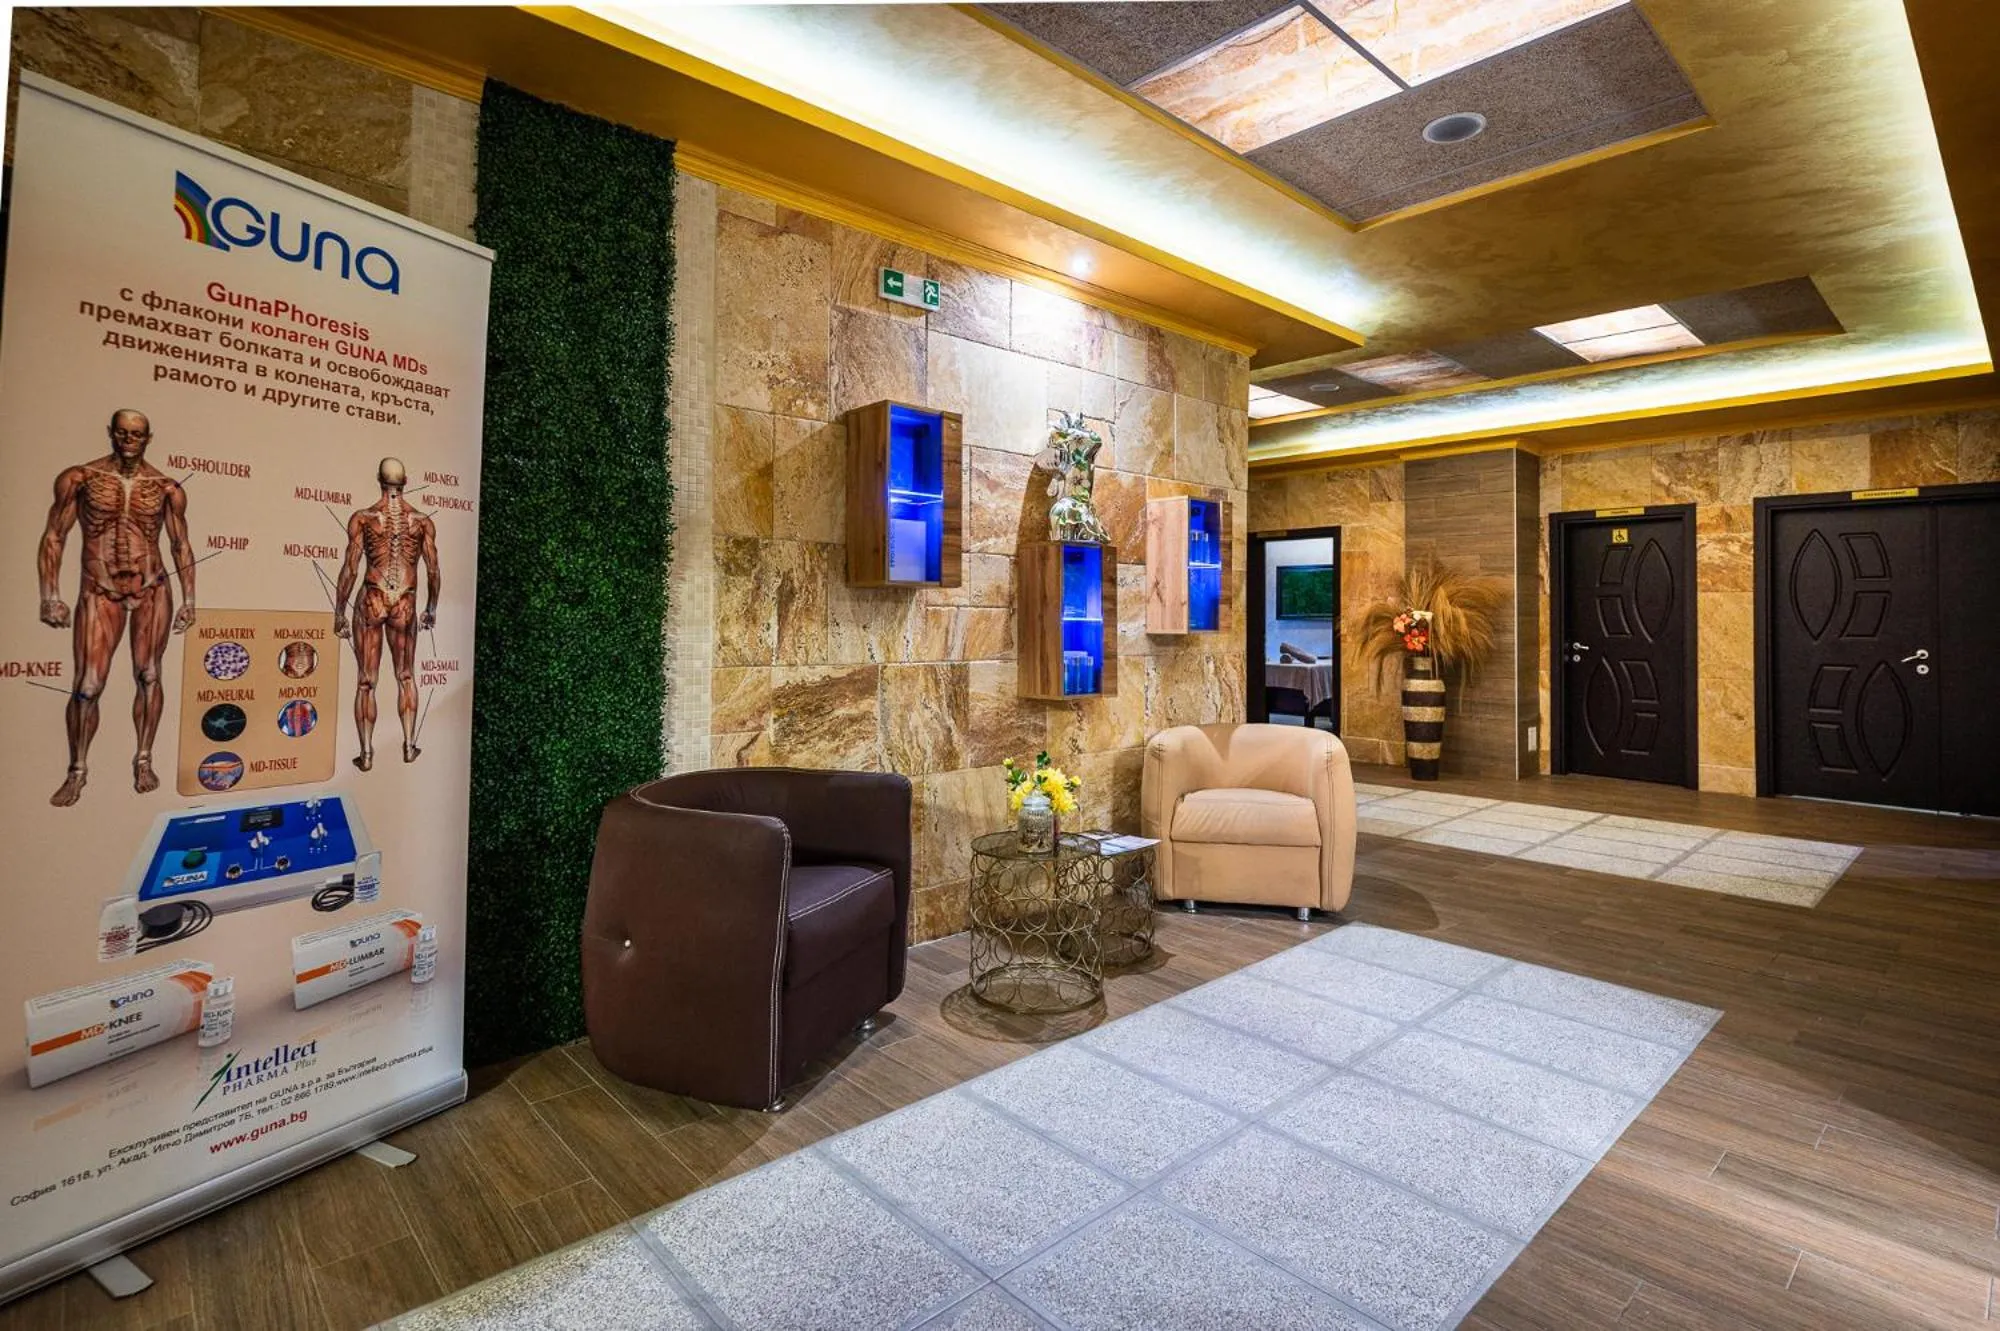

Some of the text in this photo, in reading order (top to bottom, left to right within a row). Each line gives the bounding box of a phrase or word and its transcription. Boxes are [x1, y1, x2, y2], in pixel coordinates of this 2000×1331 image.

[207, 282, 370, 341] GunaPhoresis
[120, 286, 428, 375] с флакони колаген GUNA MDs
[79, 300, 450, 399] премахват болката и освобождават
[103, 330, 435, 416] движенията в колената, кръста,
[154, 364, 402, 426] рамото и другите стави.
[167, 455, 251, 478] MD-SHOULDER
[424, 472, 460, 487] MD-NECK
[295, 487, 352, 506] MD-LUMBAR
[208, 536, 248, 550] MD-HIP
[284, 544, 338, 559] MD-ISCHIAL
[199, 628, 256, 639] MD-MATRIX
[274, 629, 325, 639] MD-MUSCLE
[422, 661, 459, 671] MD-SMALL
[420, 673, 447, 686] JOINTS
[197, 689, 255, 702] MD-NEURAL
[279, 687, 318, 699] MD-POLY
[249, 758, 298, 772] MD-TISSUE
[330, 947, 385, 972] MD-LUMBAR
[80, 1012, 143, 1040] MD-KNEE
[222, 1058, 317, 1096] PHARMA Plus
[108, 1127, 180, 1158] Ексклузивен
[182, 1101, 252, 1132] представител
[270, 1084, 299, 1100] GUNA
[209, 1110, 308, 1153] www.guna.bg
[10, 1184, 56, 1206] София
[184, 1119, 235, 1144] Димитров
[281, 1095, 292, 1105] 02
